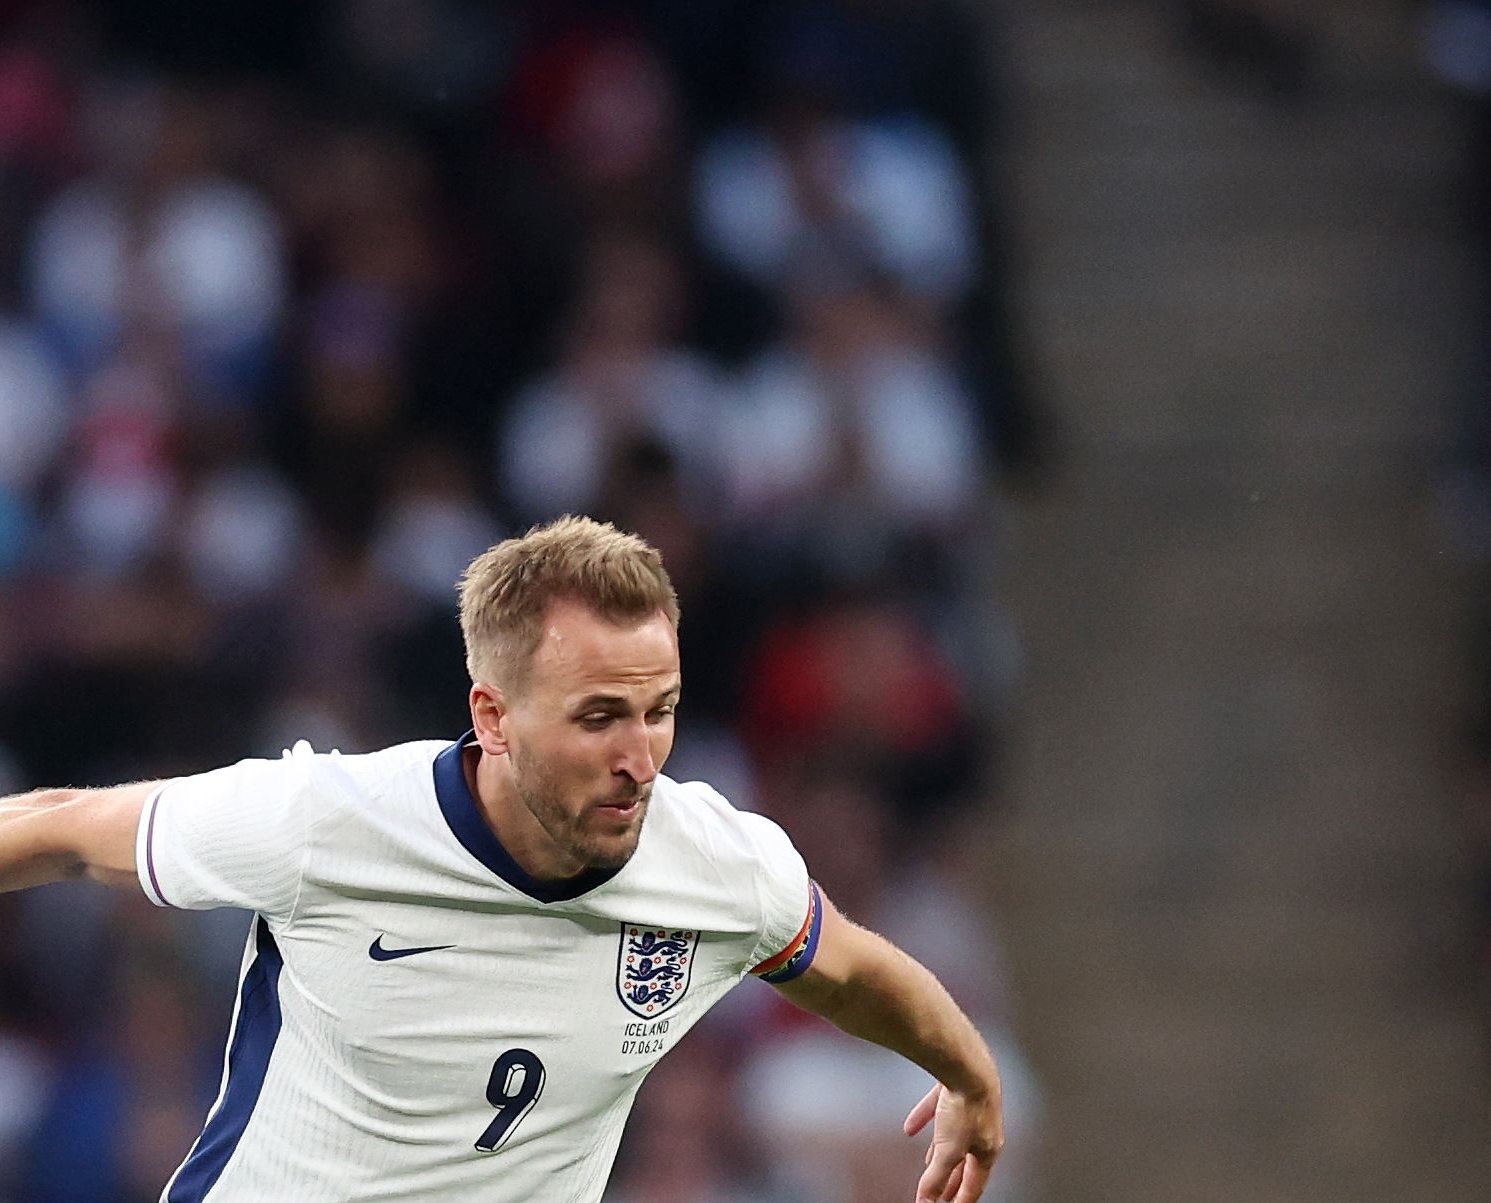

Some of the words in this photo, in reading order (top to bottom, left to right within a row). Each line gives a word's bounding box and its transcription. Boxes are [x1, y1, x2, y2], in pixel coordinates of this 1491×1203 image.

[624, 1020, 670, 1037] ICELAND
[621, 1038, 664, 1054] 07.06.24
[474, 1048, 546, 1152] 9
